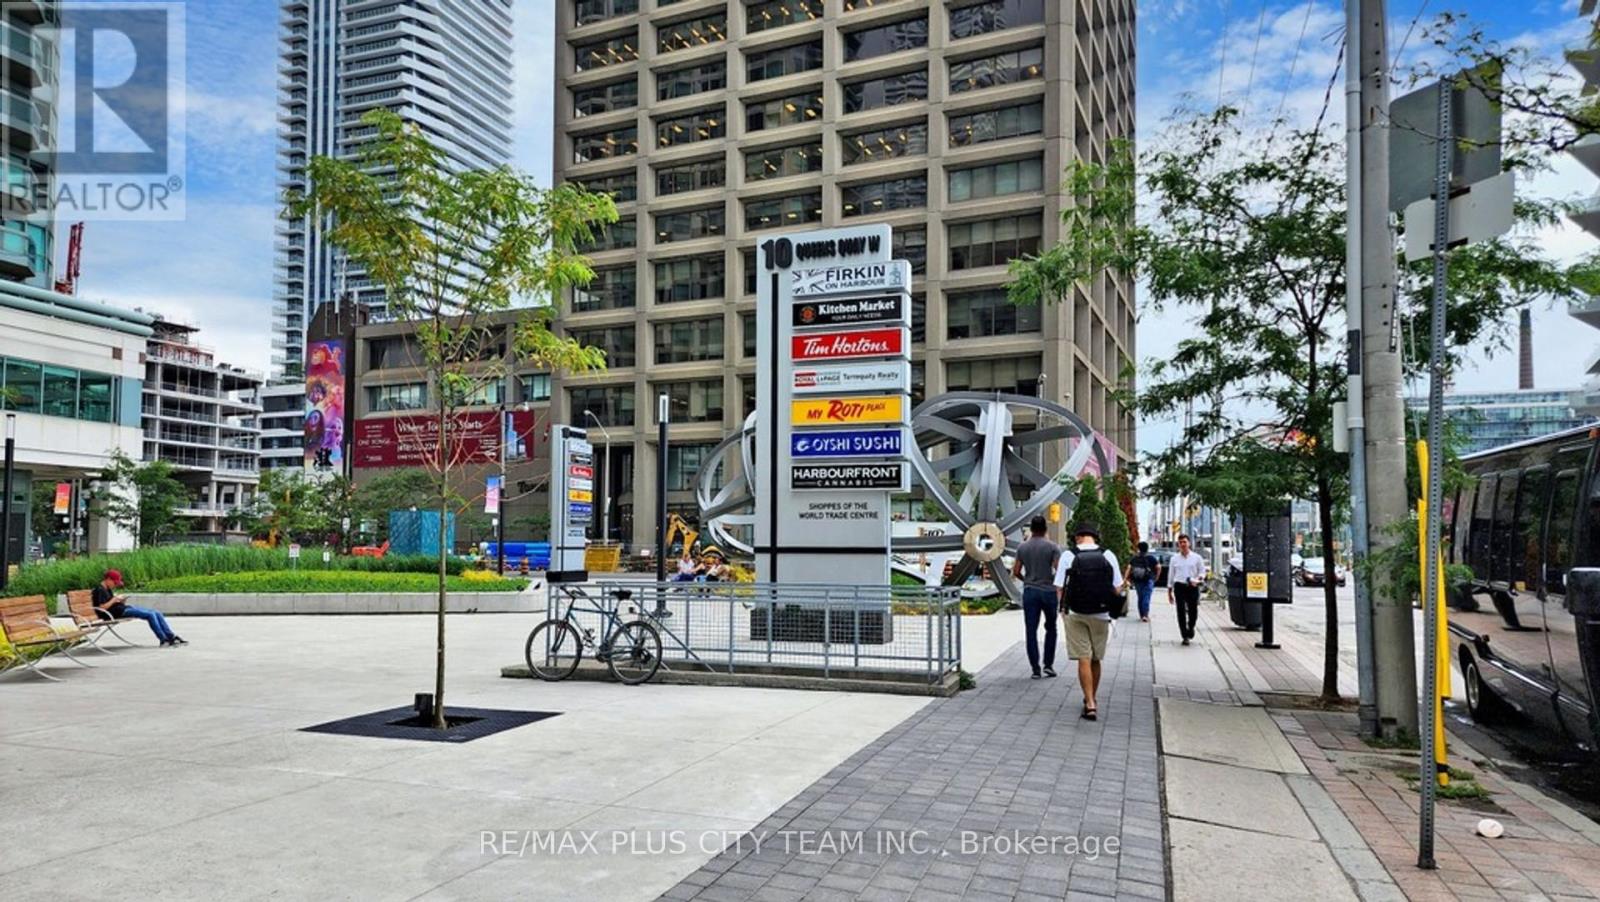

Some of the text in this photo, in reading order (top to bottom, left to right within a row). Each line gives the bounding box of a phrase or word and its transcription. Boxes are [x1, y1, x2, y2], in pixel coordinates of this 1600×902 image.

[760, 234, 880, 270] 10 QUEENS QUAY W
[826, 265, 886, 282] FIRKIN
[825, 279, 886, 290] ON HARBOUR
[818, 300, 894, 315] Kitchen Market
[803, 336, 888, 356] Tim Hortons
[878, 372, 898, 380] Realty
[806, 410, 823, 420] MY
[828, 400, 865, 422] ROTI
[812, 436, 900, 452] OYSHI SUSHI
[793, 466, 898, 479] HARBOURFRONT
[808, 502, 868, 510] SHOPPES OF THE
[799, 512, 878, 520] WORLD TRADE CENTRE
